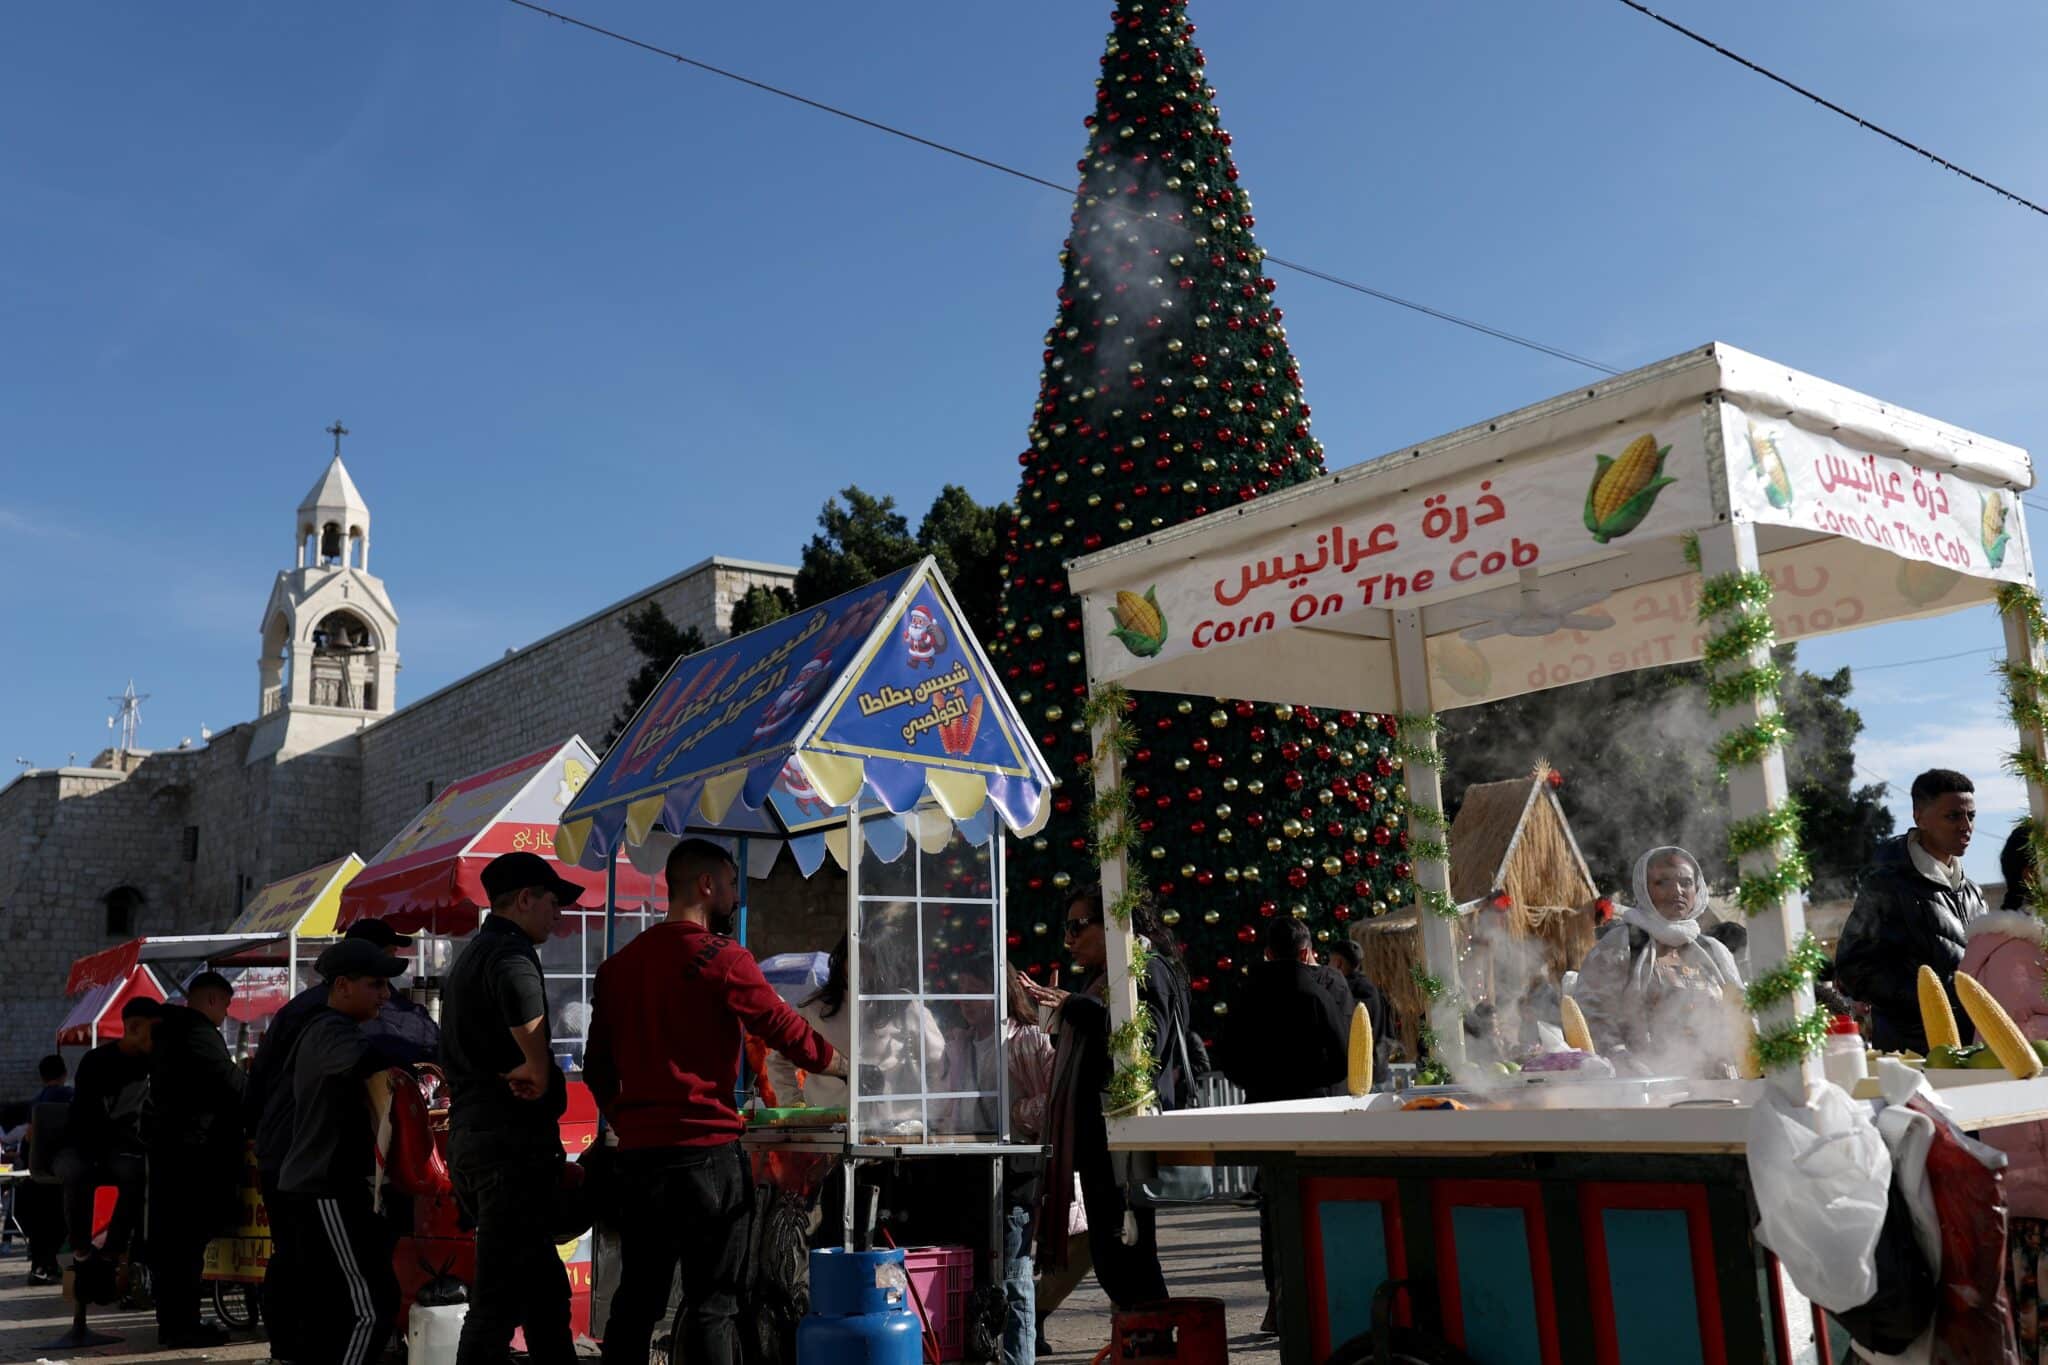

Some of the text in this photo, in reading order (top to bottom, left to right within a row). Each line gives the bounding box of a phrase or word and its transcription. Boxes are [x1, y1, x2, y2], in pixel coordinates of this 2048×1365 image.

[1815, 453, 1950, 520] ذرة عرانيس
[1214, 480, 1506, 606] ذرة عرانيس
[1864, 513, 1896, 549] On
[1894, 521, 1934, 557] The
[1934, 532, 1971, 568] Cob
[1191, 537, 1540, 648] Corn On The Cob
[859, 660, 971, 716] شيبس بطاطا
